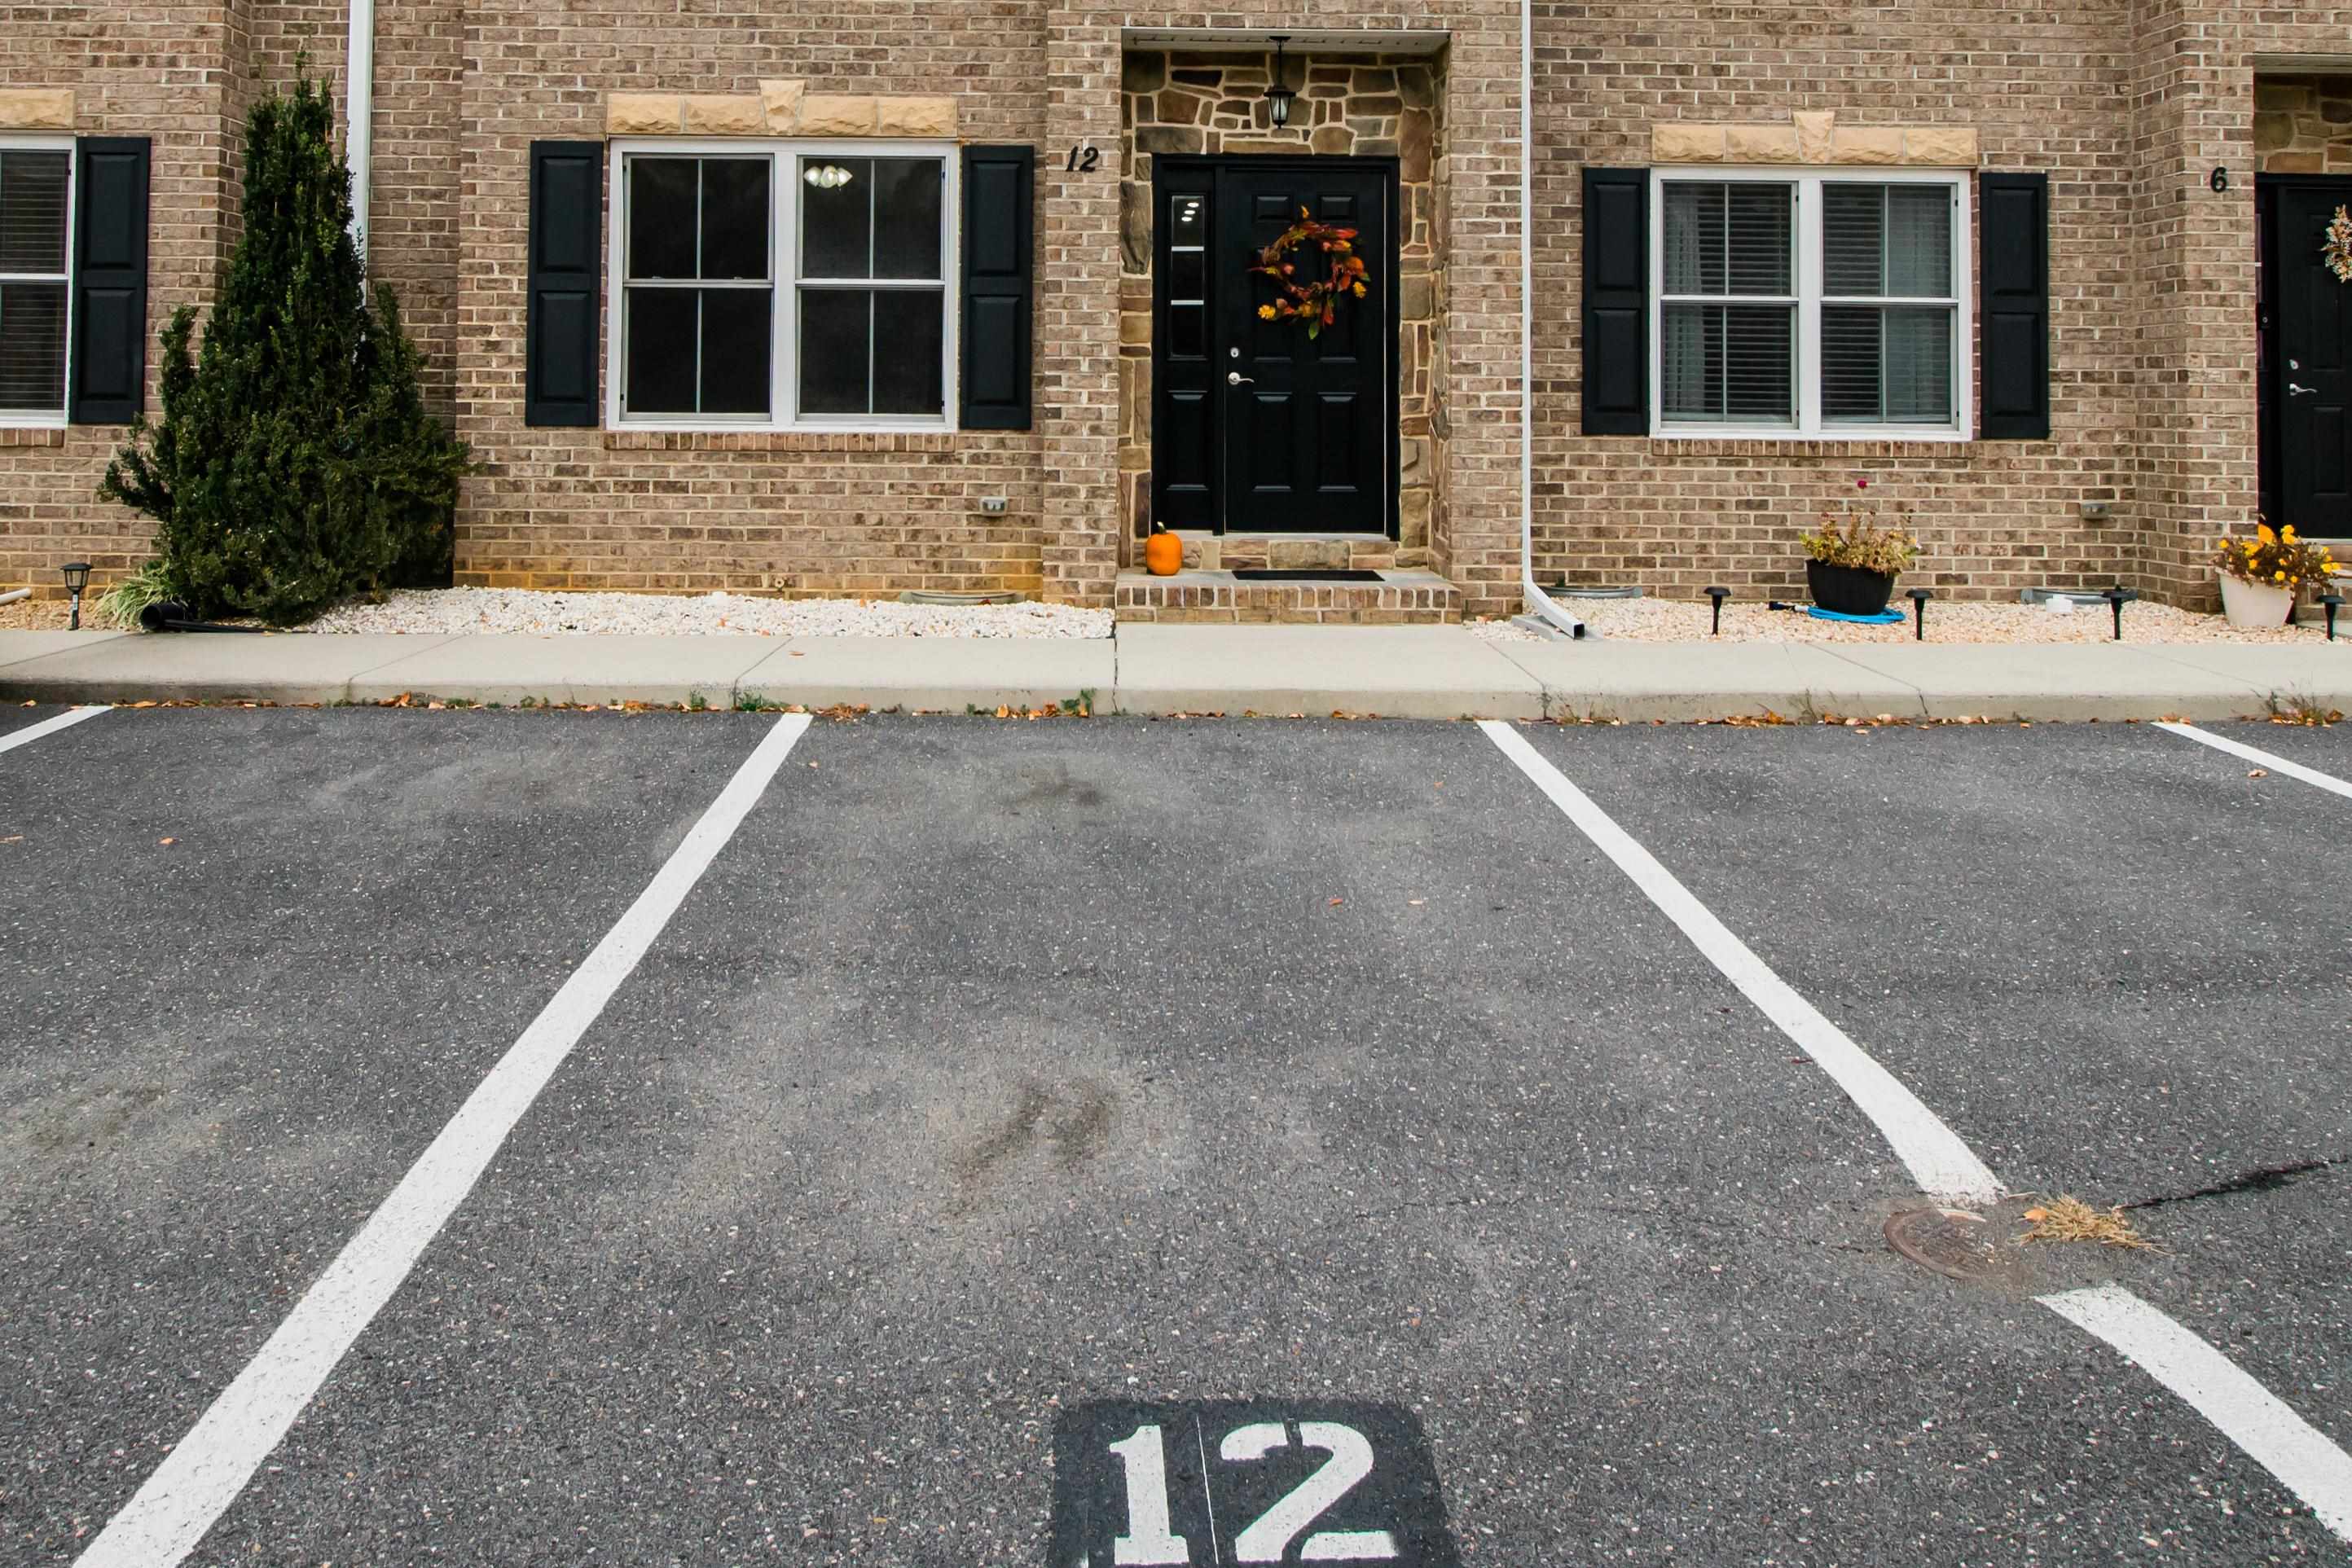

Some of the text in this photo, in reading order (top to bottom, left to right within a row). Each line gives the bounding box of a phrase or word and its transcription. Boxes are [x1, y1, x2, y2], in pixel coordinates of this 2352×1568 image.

[1066, 146, 1099, 172] 12
[2210, 166, 2227, 193] 6
[1109, 1421, 1399, 1566] 12
